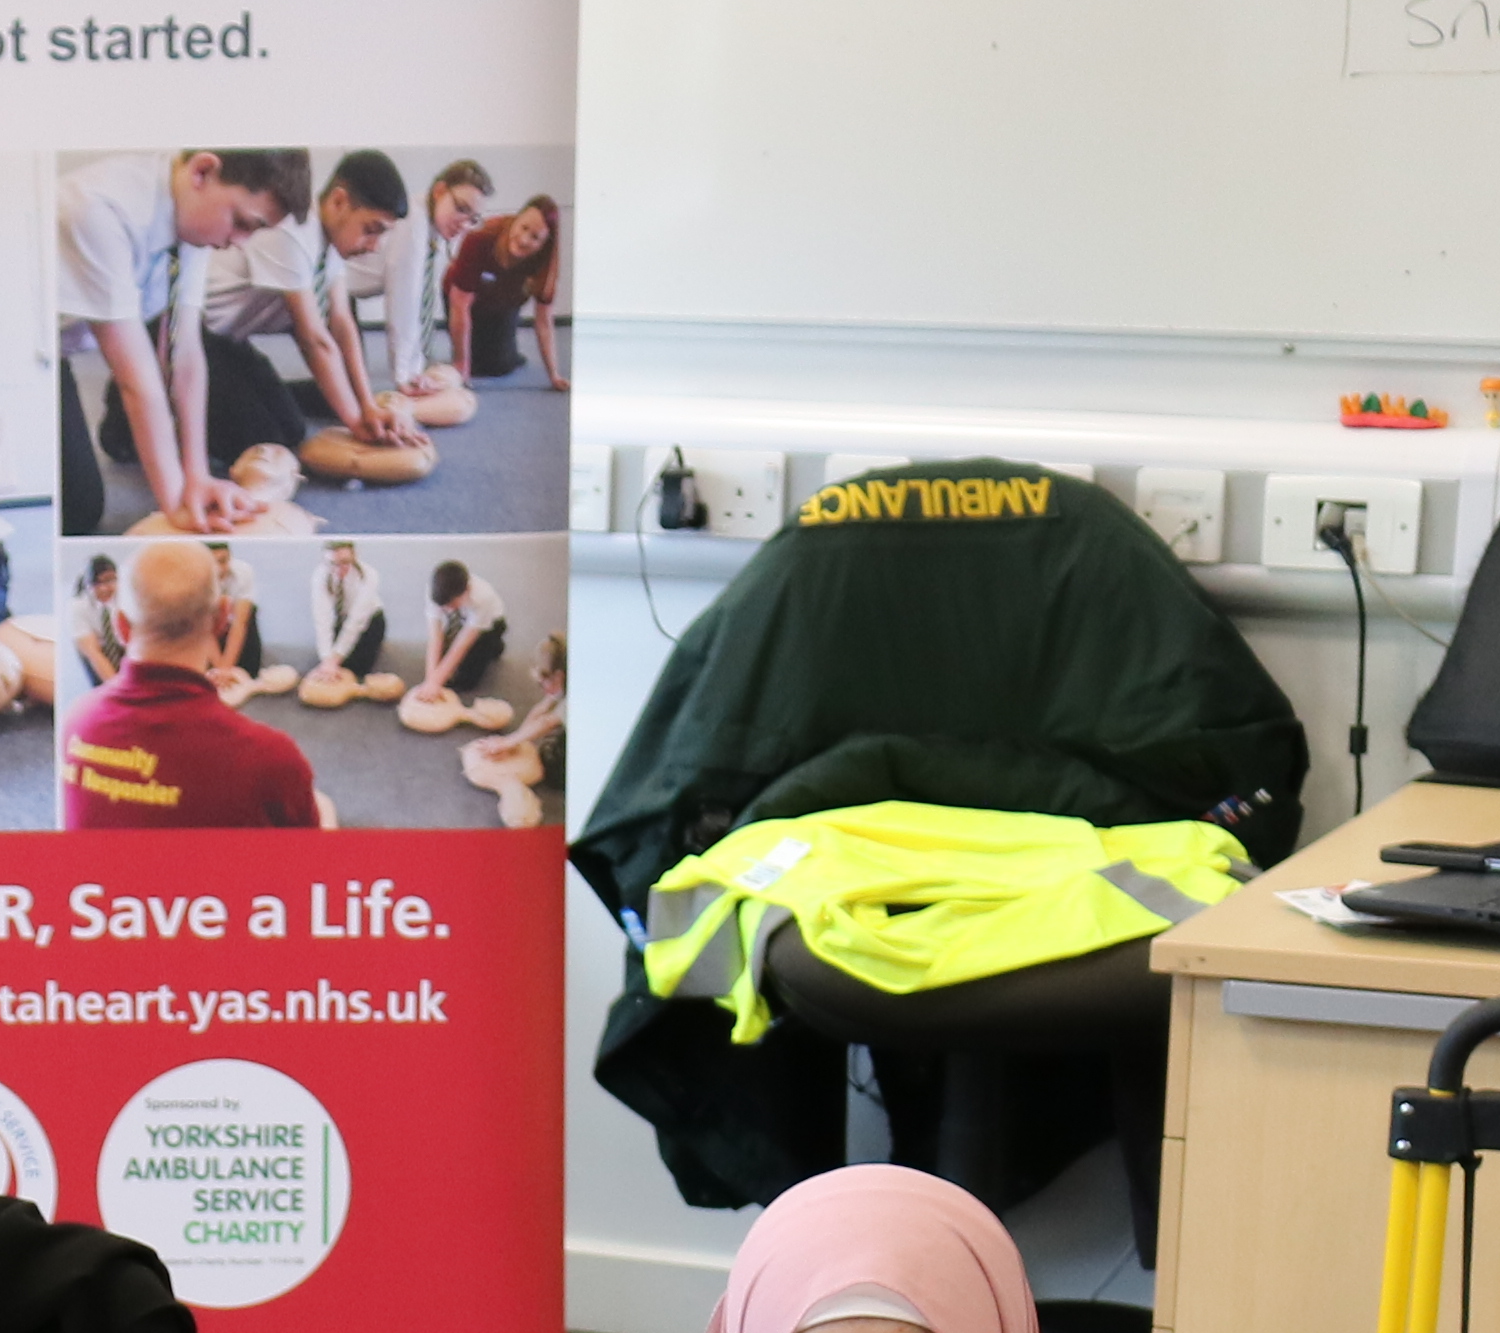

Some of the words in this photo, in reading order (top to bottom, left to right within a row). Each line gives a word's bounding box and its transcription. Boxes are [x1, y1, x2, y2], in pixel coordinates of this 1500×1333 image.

[47, 11, 269, 62] started.
[799, 476, 1052, 527] AMBULANCE
[69, 882, 230, 941] Save
[247, 893, 289, 941] a
[309, 878, 451, 940] Life.
[145, 1097, 219, 1112] Sponsored
[222, 1097, 241, 1113] by
[145, 1124, 305, 1149] YORKSHIRE
[122, 1156, 305, 1180] AMBULANCE
[193, 1188, 305, 1213] SERVICE
[183, 1220, 305, 1245] CHARITY
